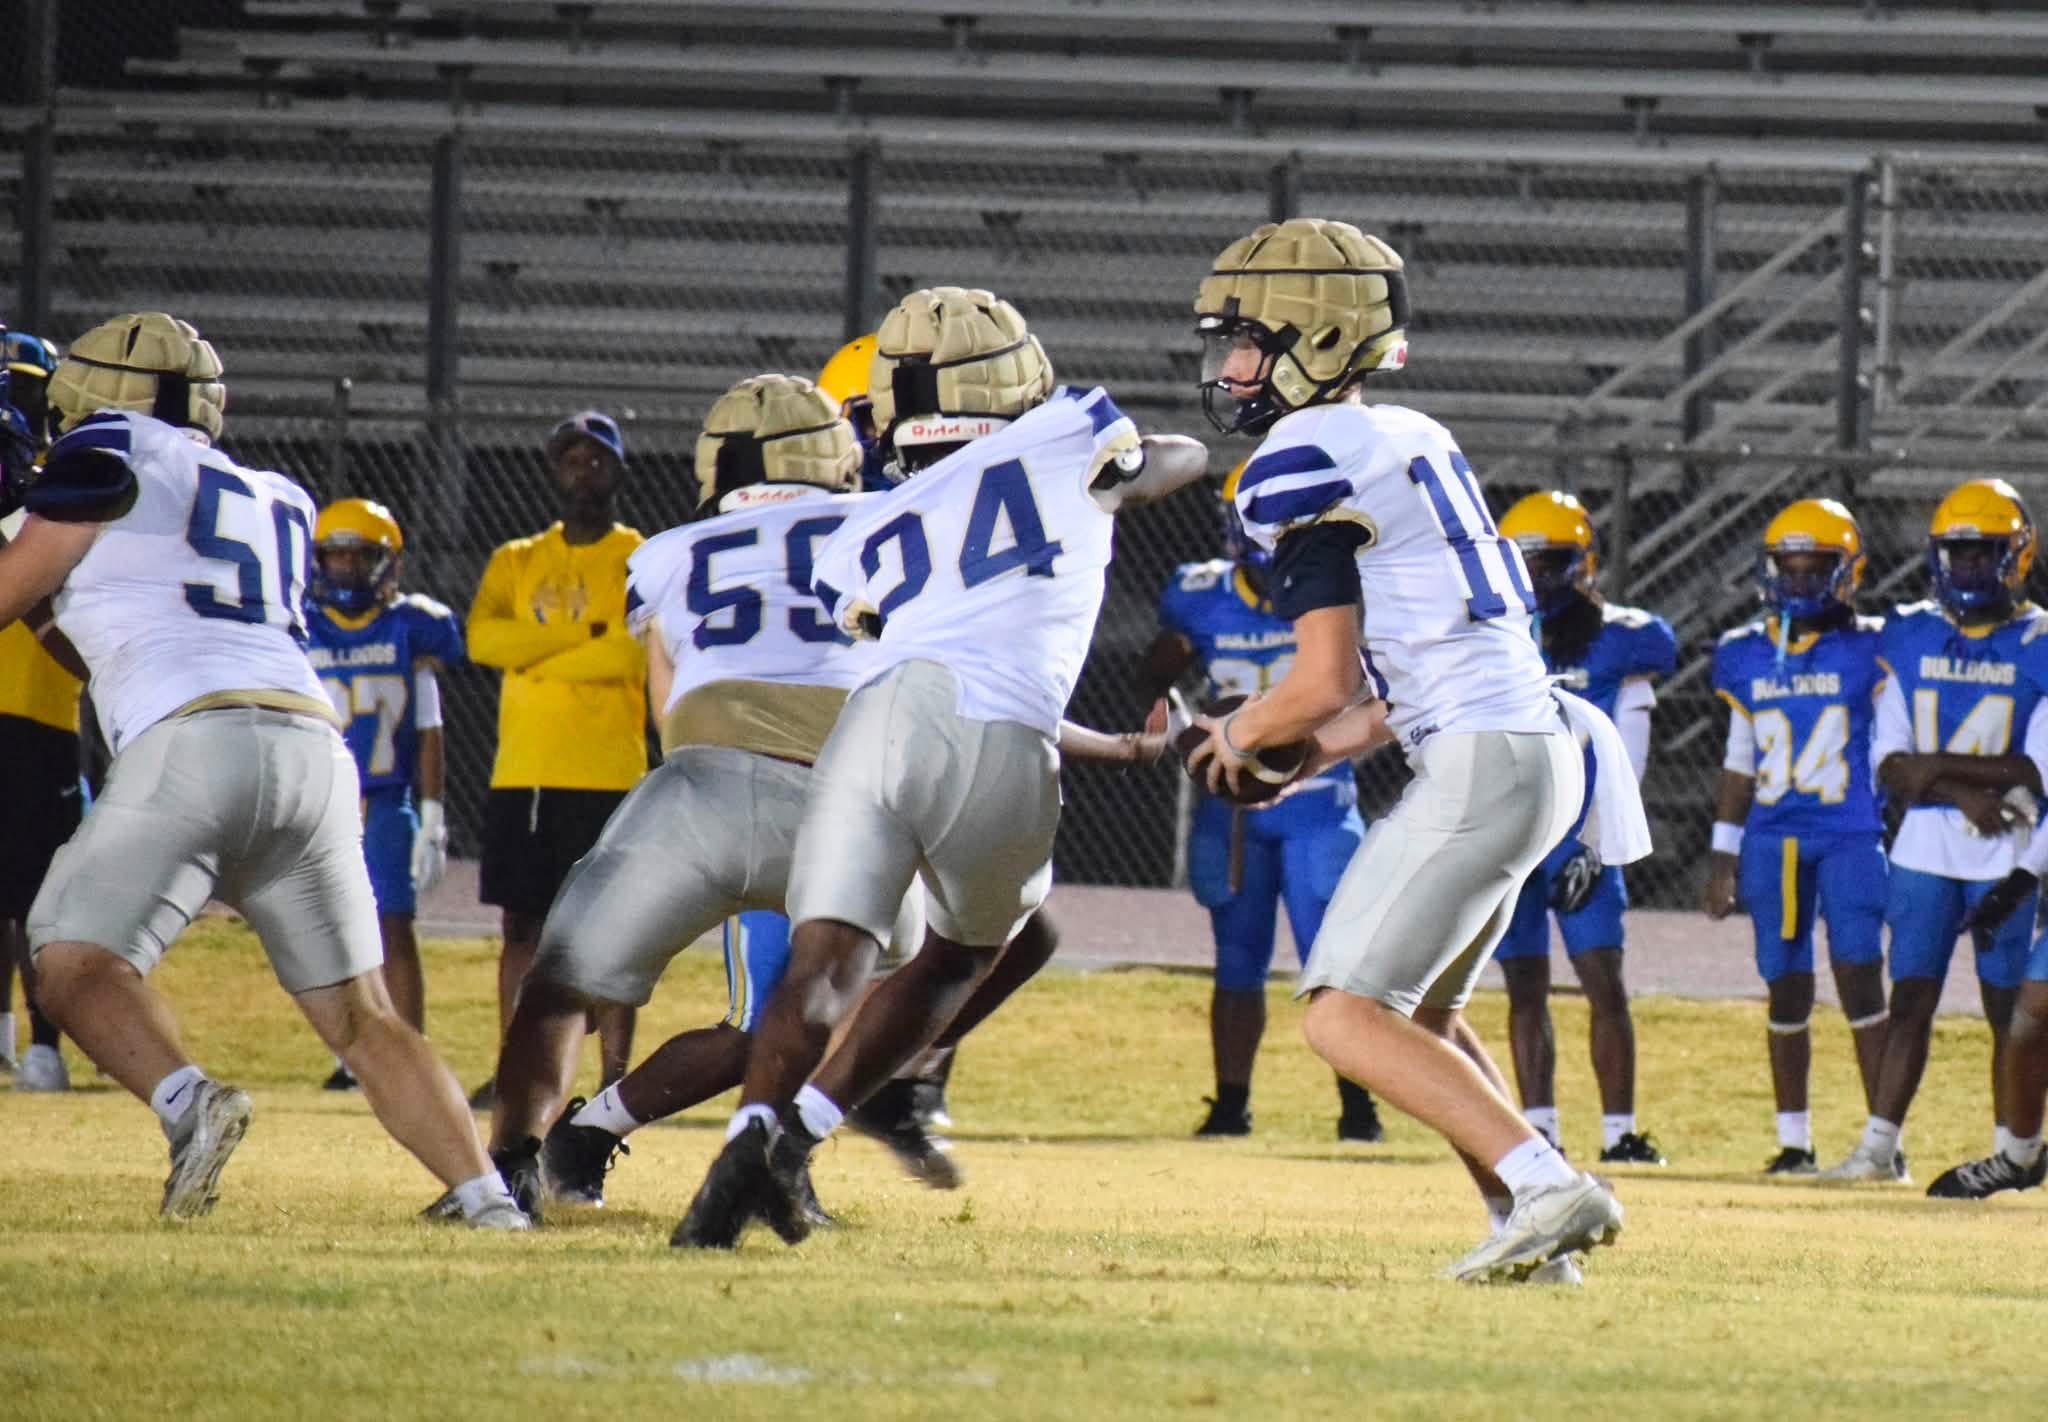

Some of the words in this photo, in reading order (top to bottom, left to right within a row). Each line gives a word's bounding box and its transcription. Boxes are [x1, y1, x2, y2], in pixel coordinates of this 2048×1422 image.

[860, 457, 1065, 627] 24
[1919, 655, 2016, 686] BULLDOGS
[1914, 688, 2015, 755] 14
